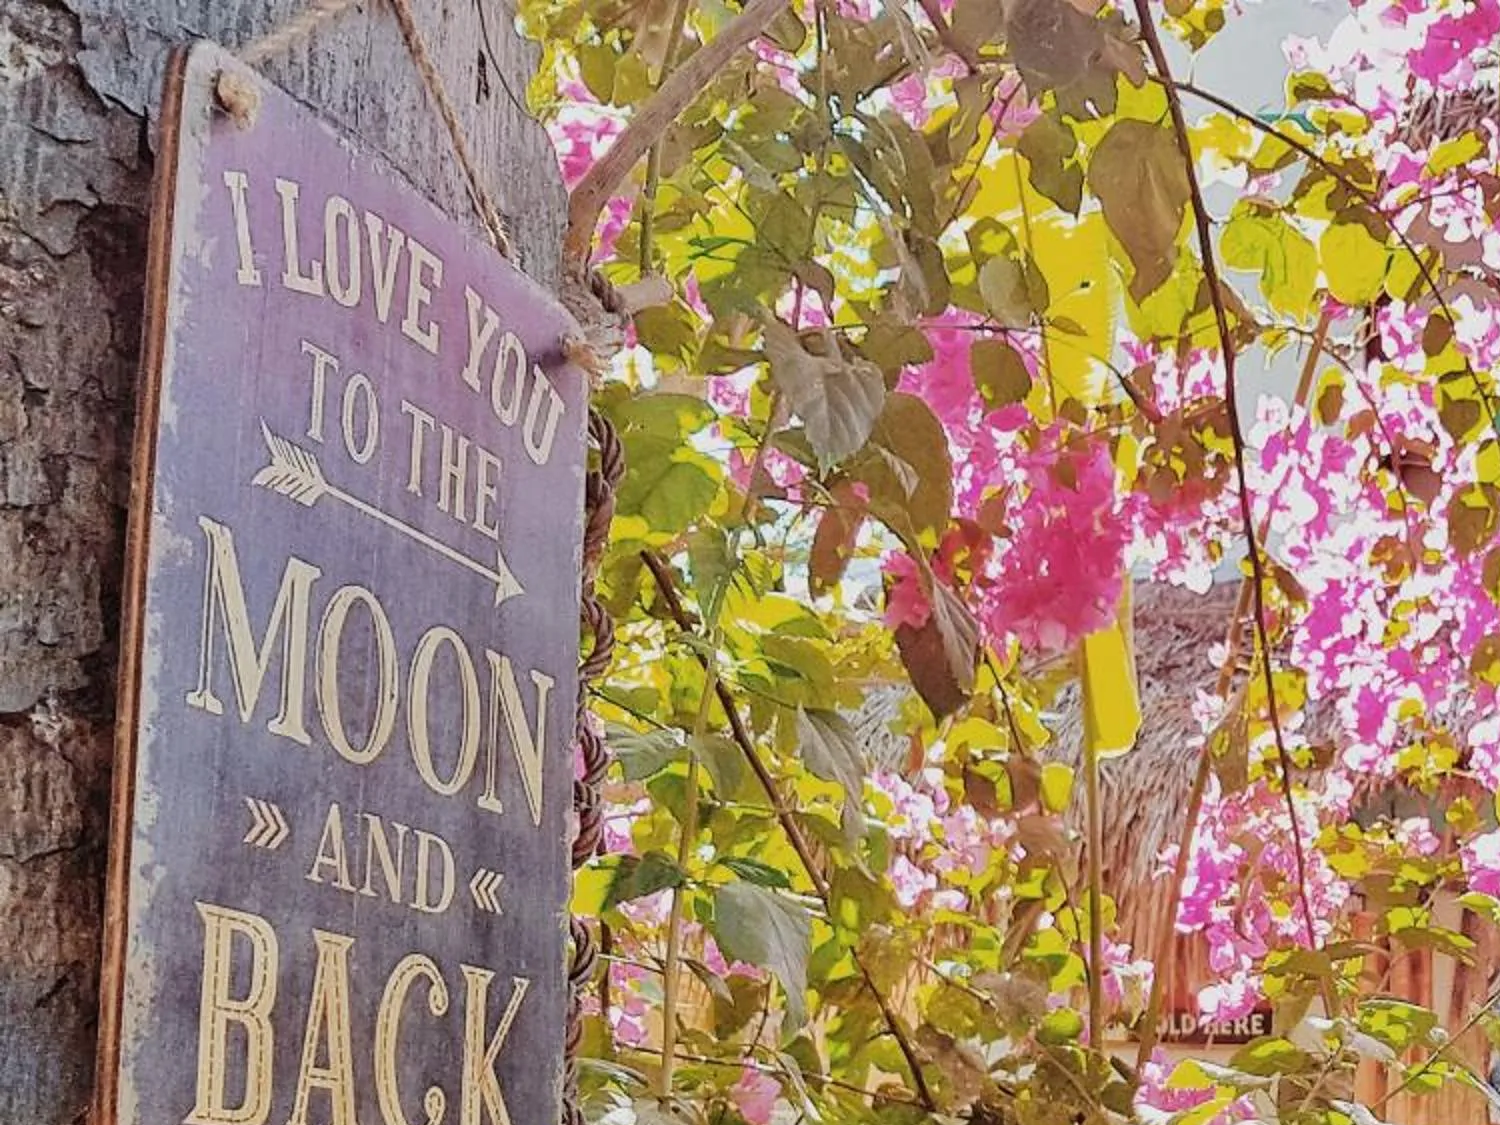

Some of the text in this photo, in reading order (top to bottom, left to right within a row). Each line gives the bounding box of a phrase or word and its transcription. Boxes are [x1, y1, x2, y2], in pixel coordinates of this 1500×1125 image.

[223, 170, 566, 466] I LOVE YOU
[301, 339, 502, 541] TO THE
[185, 514, 555, 828] MOON
[306, 802, 456, 914] AND
